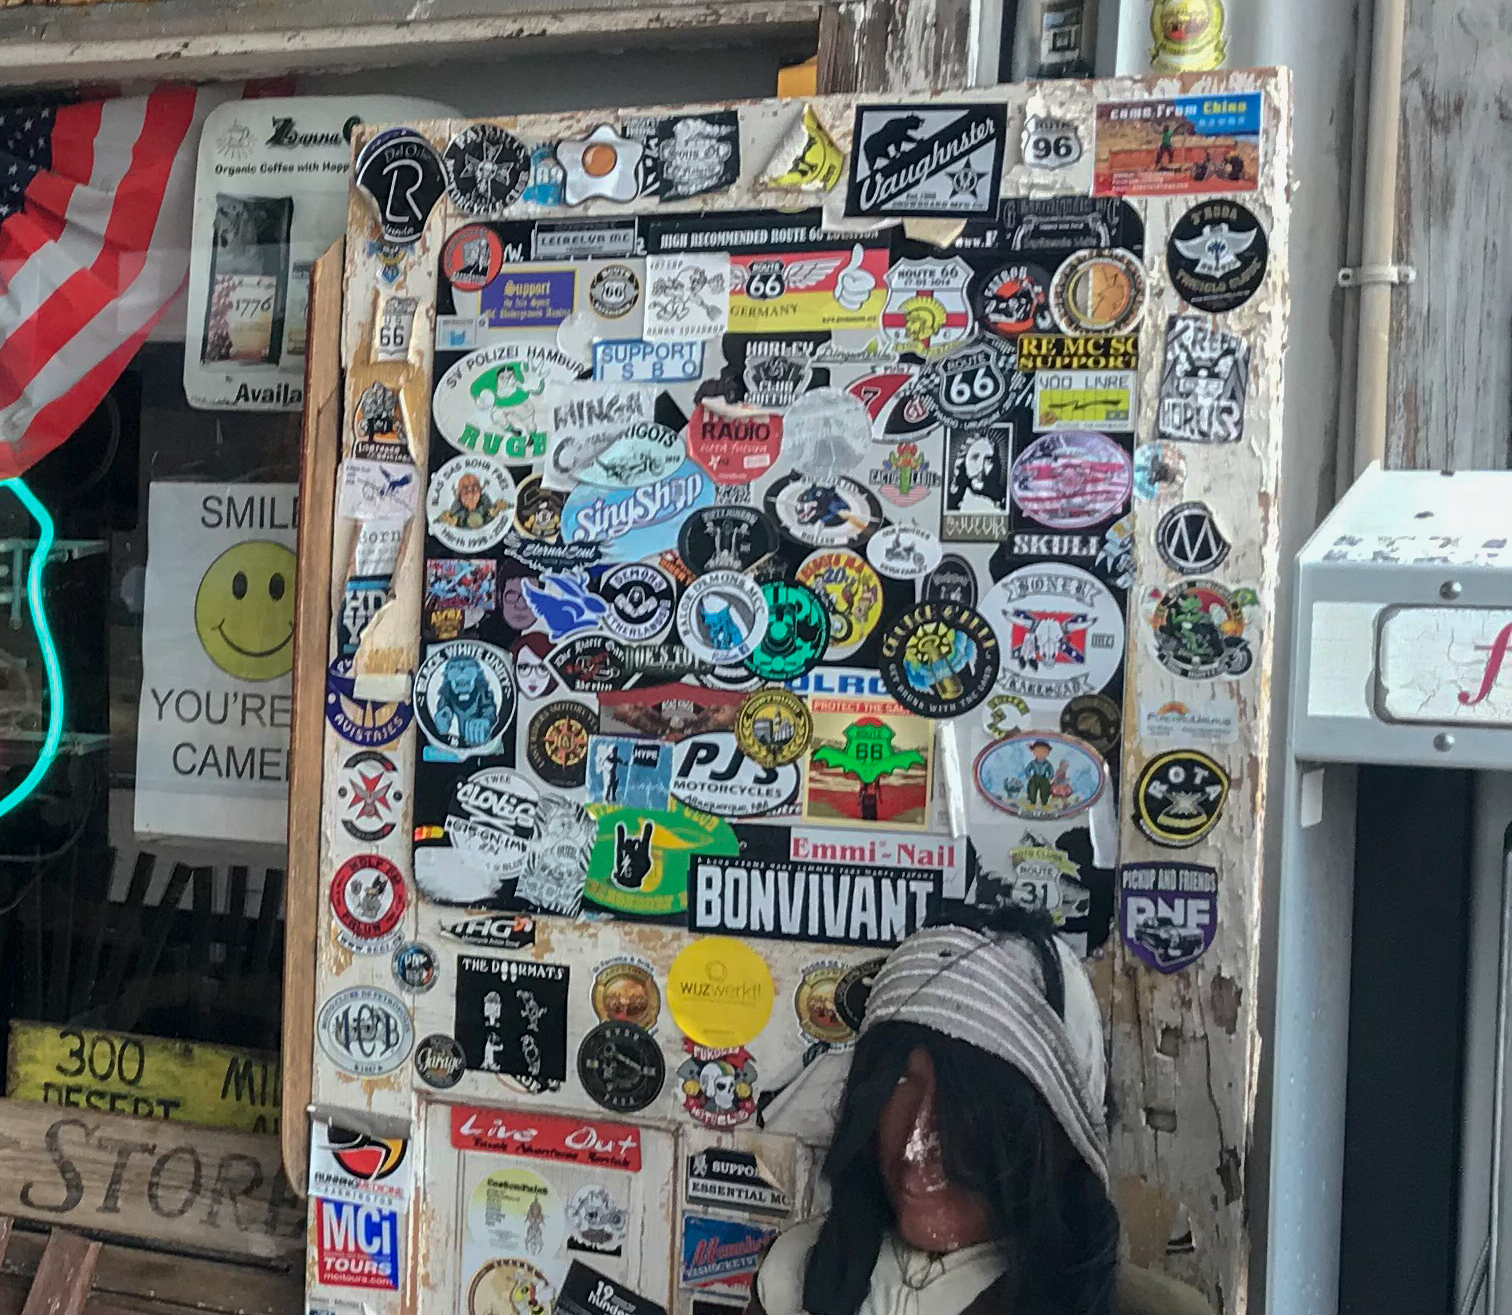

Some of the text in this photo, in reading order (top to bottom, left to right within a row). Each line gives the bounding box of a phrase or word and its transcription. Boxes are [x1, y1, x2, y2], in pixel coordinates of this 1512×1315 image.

[1032, 135, 1074, 160] 96
[215, 161, 349, 177] Organic Coffee with Happ
[859, 116, 996, 212] Vaughnster
[659, 232, 688, 249] HIGH
[690, 229, 768, 249] RECOMMENDED
[770, 227, 807, 244] ROUTE
[751, 262, 781, 273] ROUTE
[897, 265, 960, 279] ROUTE 66
[748, 276, 783, 296] 66
[234, 296, 273, 318] 1776
[729, 303, 799, 319] GERMANY
[379, 325, 405, 347] 66
[1021, 336, 1105, 355] RE MC
[600, 342, 699, 363] SUPPORT
[745, 340, 815, 357] HARLEY
[466, 344, 520, 372] POLIZEI
[526, 344, 588, 376] HAMBUR
[945, 352, 988, 372] ROUTE
[1018, 355, 1137, 370] SUPPORT
[234, 382, 303, 406] Availa
[861, 389, 879, 405] 7
[949, 368, 995, 405] 66
[457, 422, 549, 458] RUGB
[699, 422, 771, 442] RADIO
[199, 493, 300, 530] SMIL
[573, 472, 704, 542] SingShop
[417, 645, 512, 695] BLACK WHITE UNITY
[152, 687, 293, 729] YOU'RE
[812, 699, 862, 713] PROTECT
[632, 748, 658, 761] HYPE
[673, 780, 783, 799] MOTORCYCLES
[1147, 765, 1223, 801] ROTA
[695, 863, 934, 942] BONVIVANT
[1020, 882, 1050, 909] 31
[461, 958, 489, 975] THE
[55, 1028, 146, 1086] 300
[459, 1113, 638, 1158] Live Out
[712, 1160, 757, 1177] SUPPO
[691, 1181, 767, 1203] ESSENTIAL
[323, 1257, 393, 1277] TOURS
[596, 1280, 615, 1301] 19
